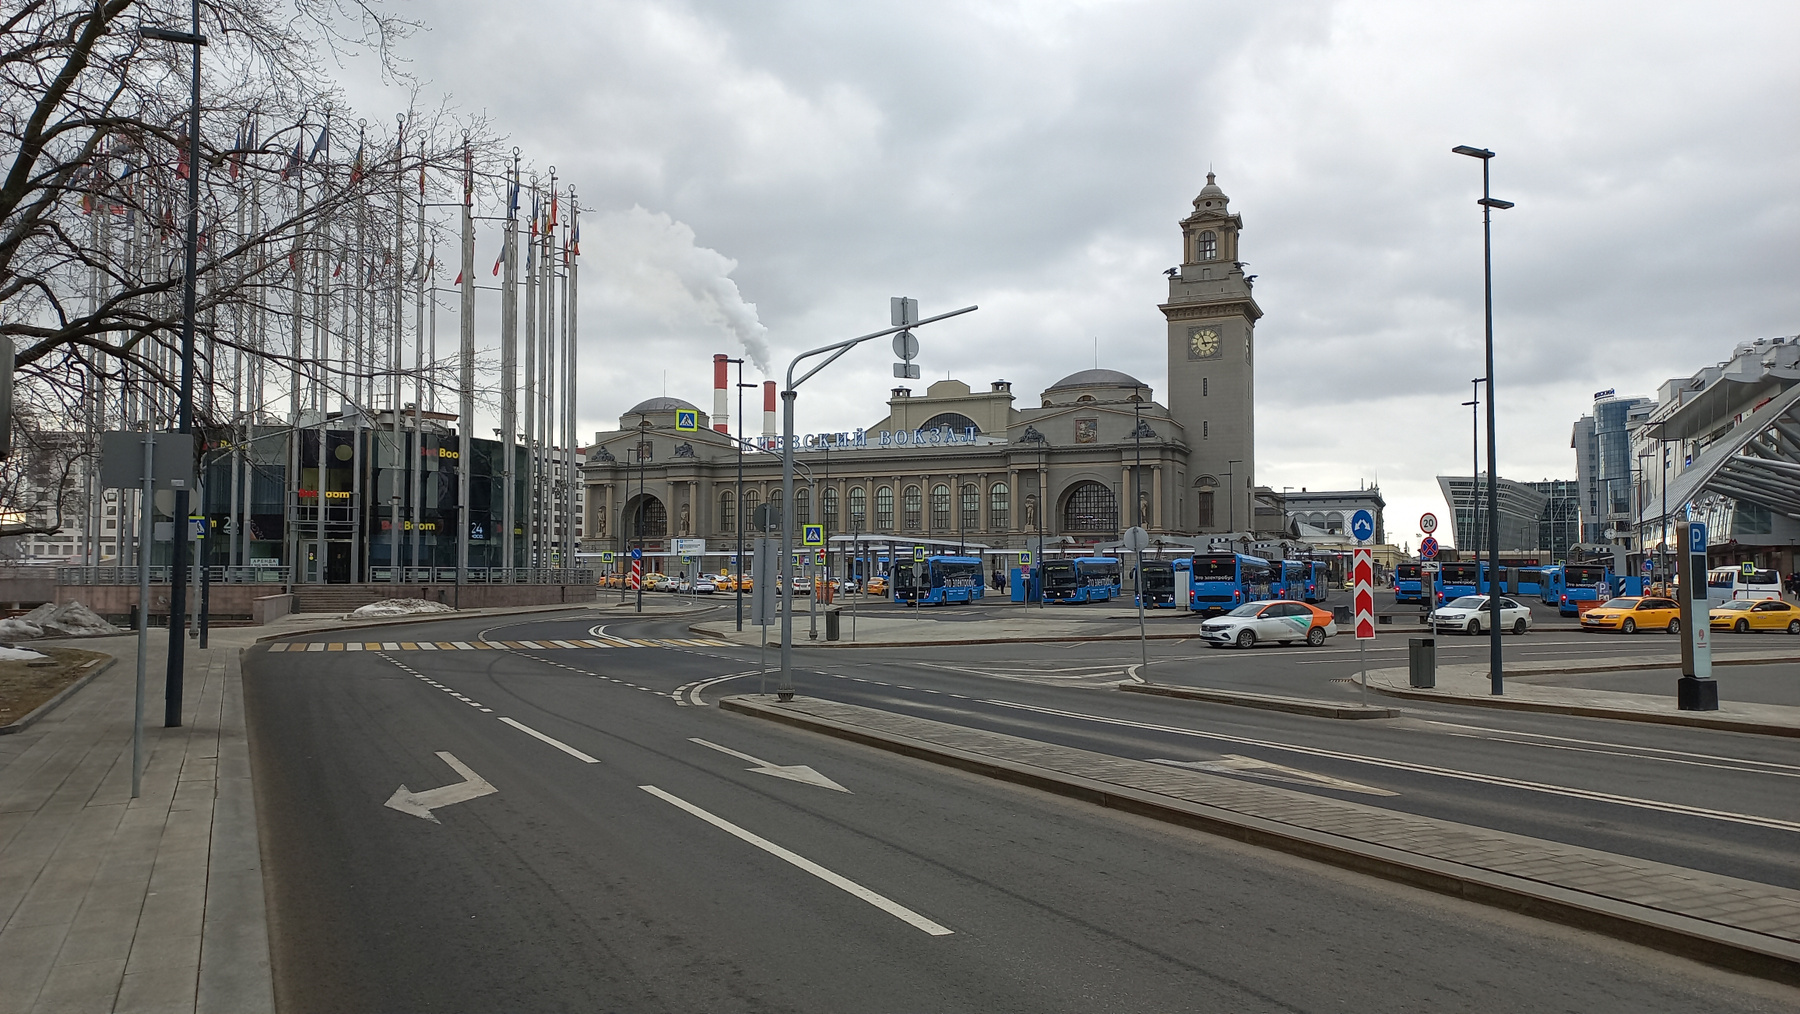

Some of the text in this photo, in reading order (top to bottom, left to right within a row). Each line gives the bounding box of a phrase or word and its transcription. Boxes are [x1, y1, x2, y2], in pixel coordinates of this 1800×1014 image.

[741, 426, 976, 451] КИЕВСКИЙ ВОКЗАЛ
[439, 447, 460, 459] Boo
[325, 491, 350, 499] oom
[471, 522, 483, 534] 24
[1423, 519, 1434, 528] 20
[1692, 529, 1701, 550] P
